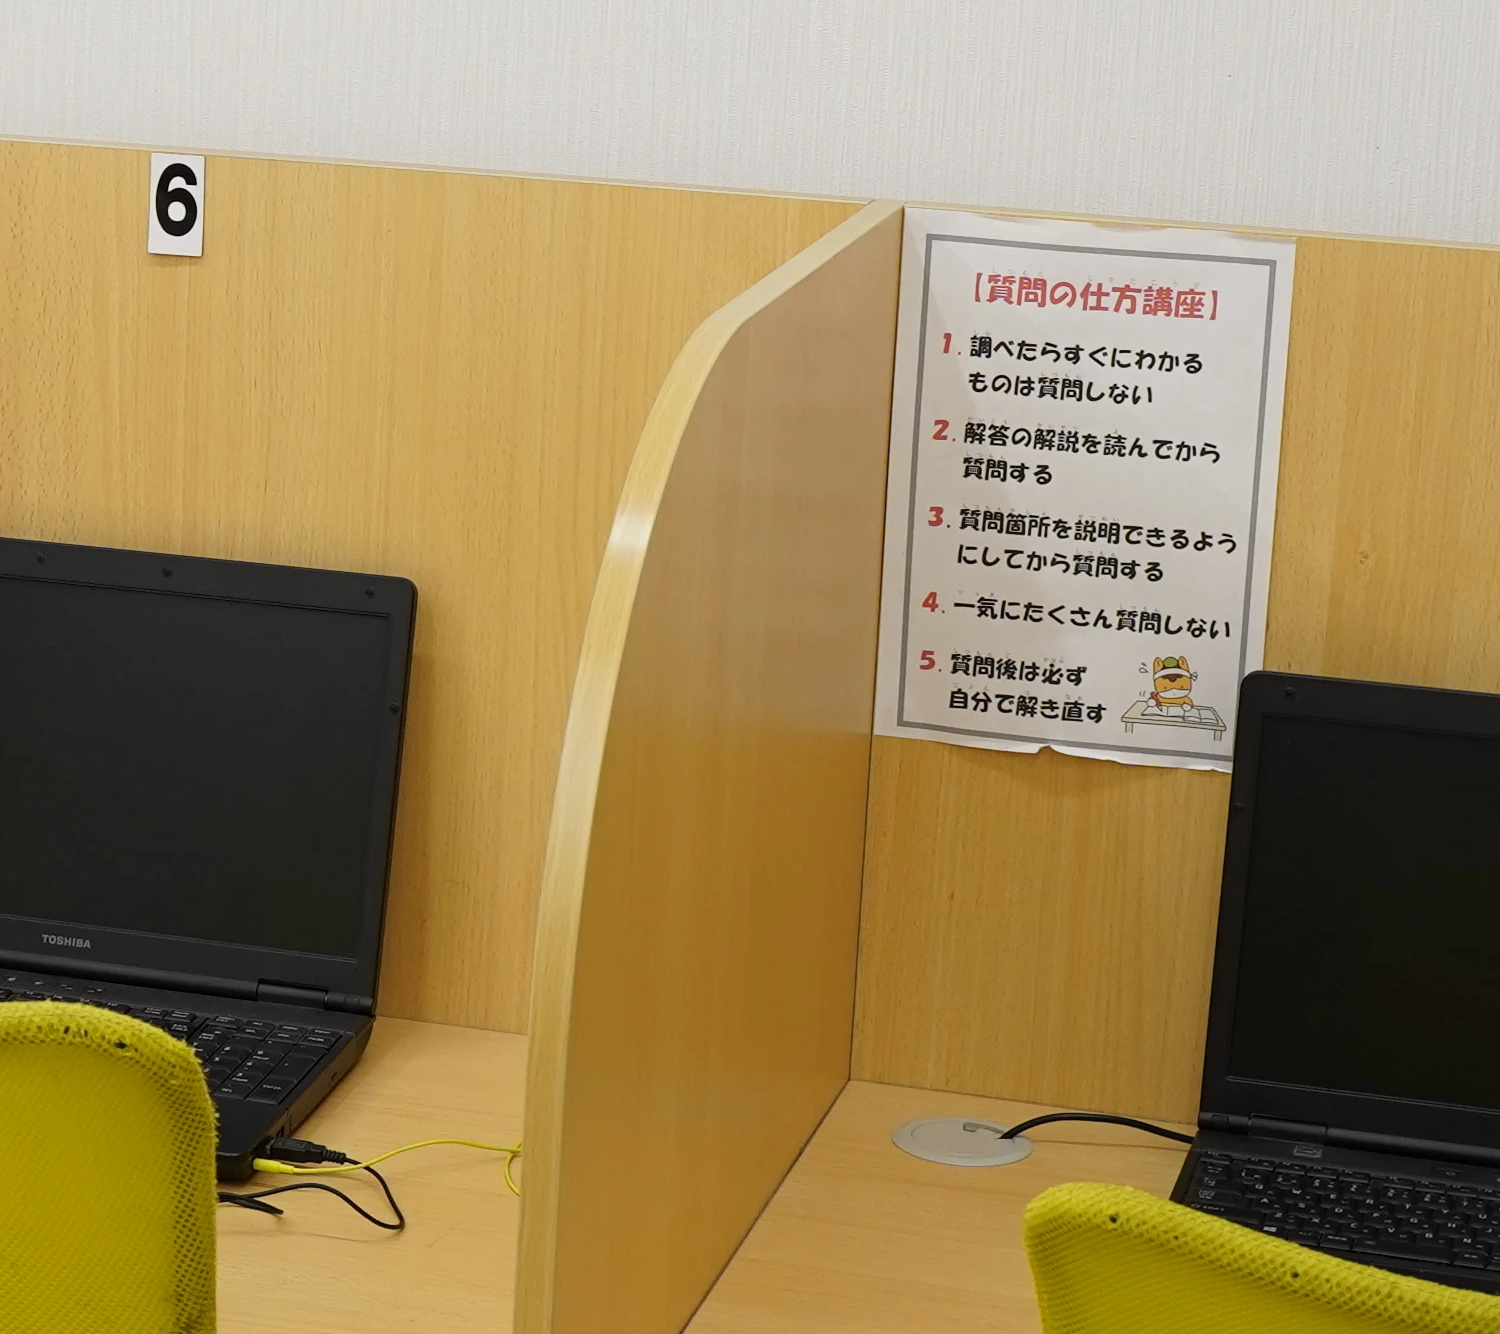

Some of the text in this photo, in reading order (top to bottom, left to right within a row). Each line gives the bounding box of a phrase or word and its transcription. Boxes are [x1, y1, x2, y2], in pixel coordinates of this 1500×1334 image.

[156, 163, 198, 237] 6
[942, 333, 1203, 375] 1. 調べたらすぐにわかる
[968, 372, 1154, 406] ものは質問しない
[932, 420, 1221, 464] 2. 解答の解説を読んでから
[963, 457, 1052, 485] 質問する
[928, 507, 1237, 554] 3. 質問箇所を説明できるよう
[957, 544, 1164, 582] にしてから質問する
[921, 592, 1231, 640] 4. 一気にたくさん質問しない
[919, 651, 1087, 686] 5. 質問後は必ず
[949, 689, 1107, 724] 自分で解き直す
[41, 933, 92, 950] TOSHIBA
